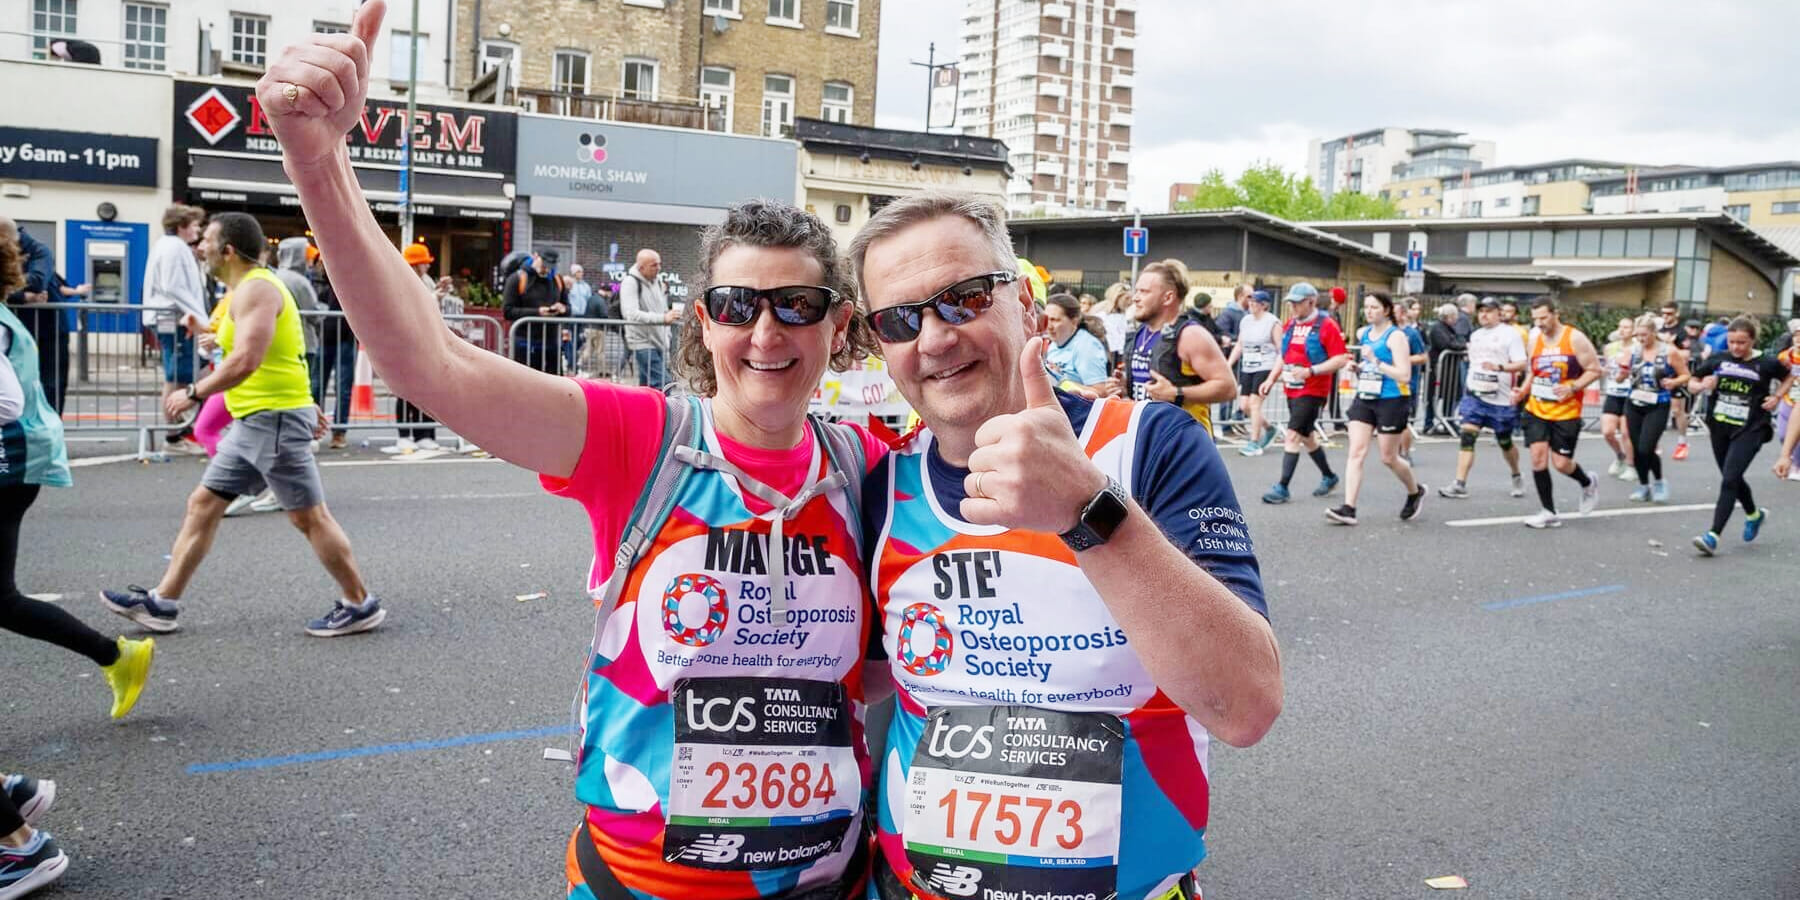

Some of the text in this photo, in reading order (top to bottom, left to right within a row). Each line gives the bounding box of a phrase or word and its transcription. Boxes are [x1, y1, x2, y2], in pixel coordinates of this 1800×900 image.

[19, 143, 66, 163] 6am
[83, 148, 140, 170] 11pm
[458, 156, 483, 167] BAR
[534, 164, 648, 184] MONREAL SHAW
[569, 183, 613, 193] LONDON
[1188, 507, 1234, 520] OXFORD
[1200, 521, 1209, 533] &
[1212, 522, 1245, 538] GOWN
[1197, 537, 1224, 549] 15th
[1225, 540, 1248, 551] MAY
[739, 581, 797, 605] Royl
[738, 603, 856, 628] Ostoporosis
[958, 603, 1024, 630] Royal
[733, 628, 810, 650] Society
[961, 627, 1128, 657] Osteoporosis
[657, 650, 693, 667] Better
[732, 653, 773, 666] health
[777, 655, 794, 667] for
[966, 655, 1052, 682] Society
[764, 688, 801, 701] TATA
[1022, 689, 1043, 704] for
[1047, 684, 1133, 704] everybody
[686, 689, 757, 732] tcs
[764, 704, 838, 720] CONSULTANCY
[764, 720, 817, 734] SERVICES
[1007, 717, 1047, 731] TATA
[928, 716, 995, 760] tcs
[1003, 733, 1109, 753] CONSULTANCY
[1000, 750, 1067, 766] SERVICES
[702, 761, 836, 809] 23684
[980, 778, 1030, 789] #WeRunTogether
[939, 789, 1084, 850] 17573
[744, 851, 776, 863] new
[778, 840, 832, 862] balance
[943, 848, 965, 856] MEDAL
[983, 889, 1018, 900] new
